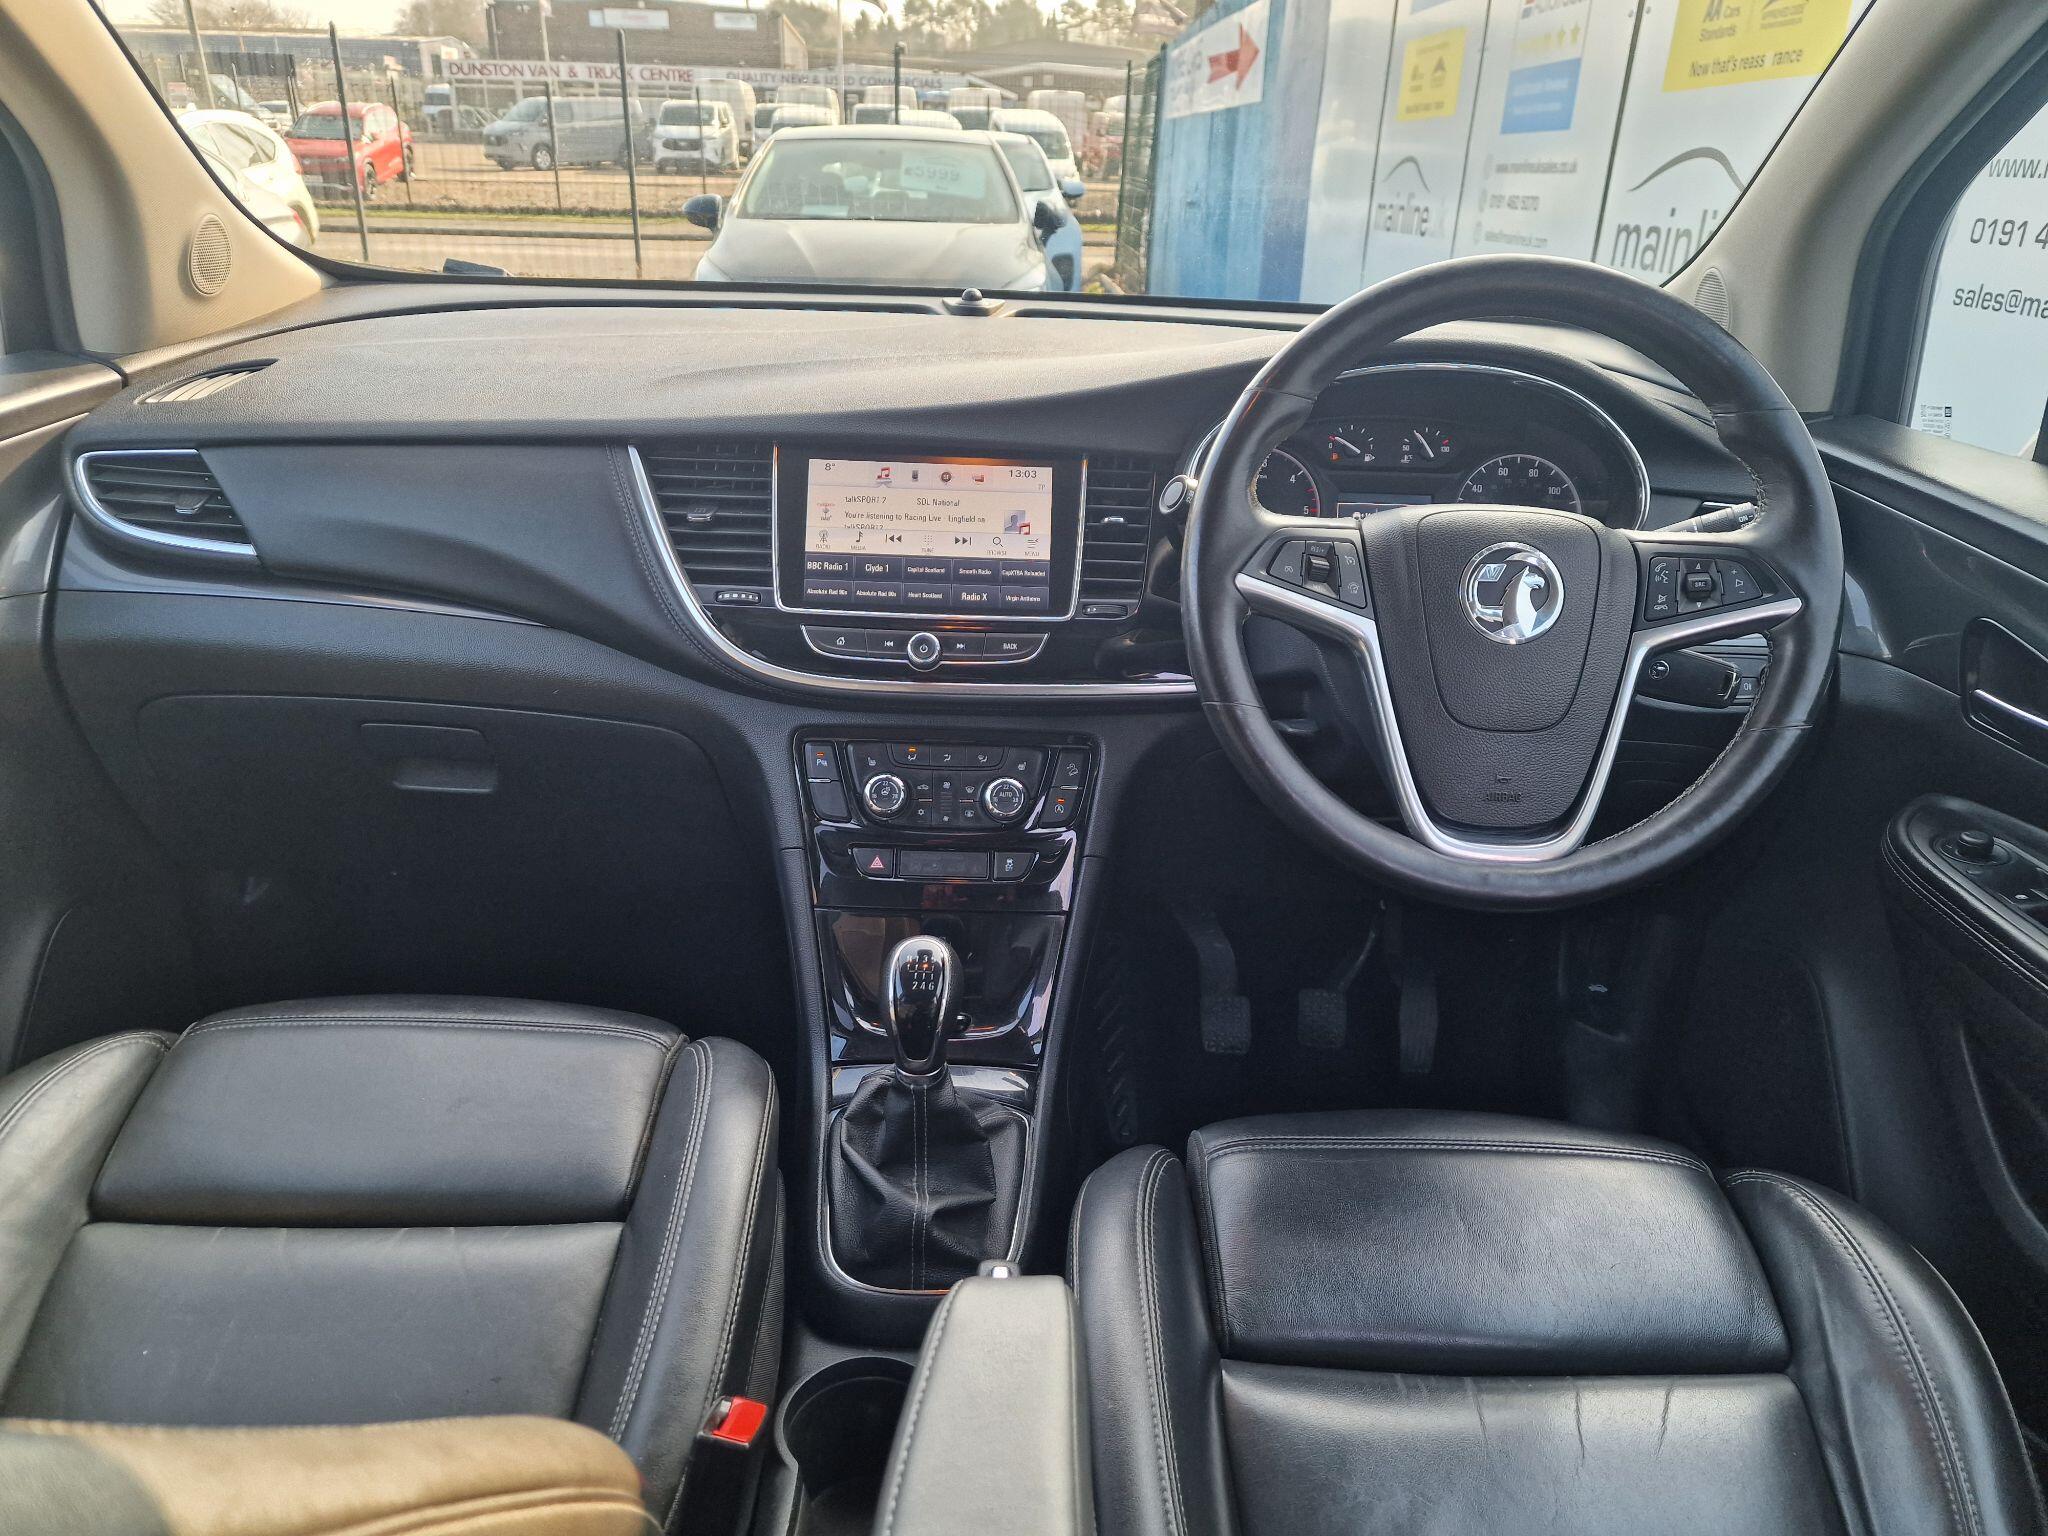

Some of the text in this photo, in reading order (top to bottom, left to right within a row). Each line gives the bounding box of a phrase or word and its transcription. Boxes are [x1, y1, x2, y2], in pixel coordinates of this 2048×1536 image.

[1689, 61, 1709, 77] Now
[1711, 55, 1738, 74] that's
[449, 62, 525, 77] DUNSTON
[528, 64, 560, 77] VAN
[568, 66, 578, 77] &
[640, 68, 694, 82] CENTRE
[726, 71, 777, 84] QUALITY
[825, 75, 855, 86] USD
[1970, 217, 2029, 247] 0191
[1009, 470, 1037, 479] 13:03
[1498, 467, 1509, 476] 60
[1528, 468, 1539, 478] 80
[1289, 475, 1296, 484] 4
[1472, 484, 1483, 493] 40
[1548, 486, 1561, 495] 100
[1303, 507, 1309, 515] 5
[845, 511, 864, 519] You're
[866, 512, 893, 522] listening
[904, 513, 927, 522] Racing
[928, 514, 941, 522] Live
[807, 561, 823, 570] BBC
[823, 562, 843, 571] Radio
[865, 563, 884, 573] Clyde
[961, 592, 988, 601] Radio X
[1003, 642, 1018, 650] BACK
[912, 981, 935, 990] 2 4 6
